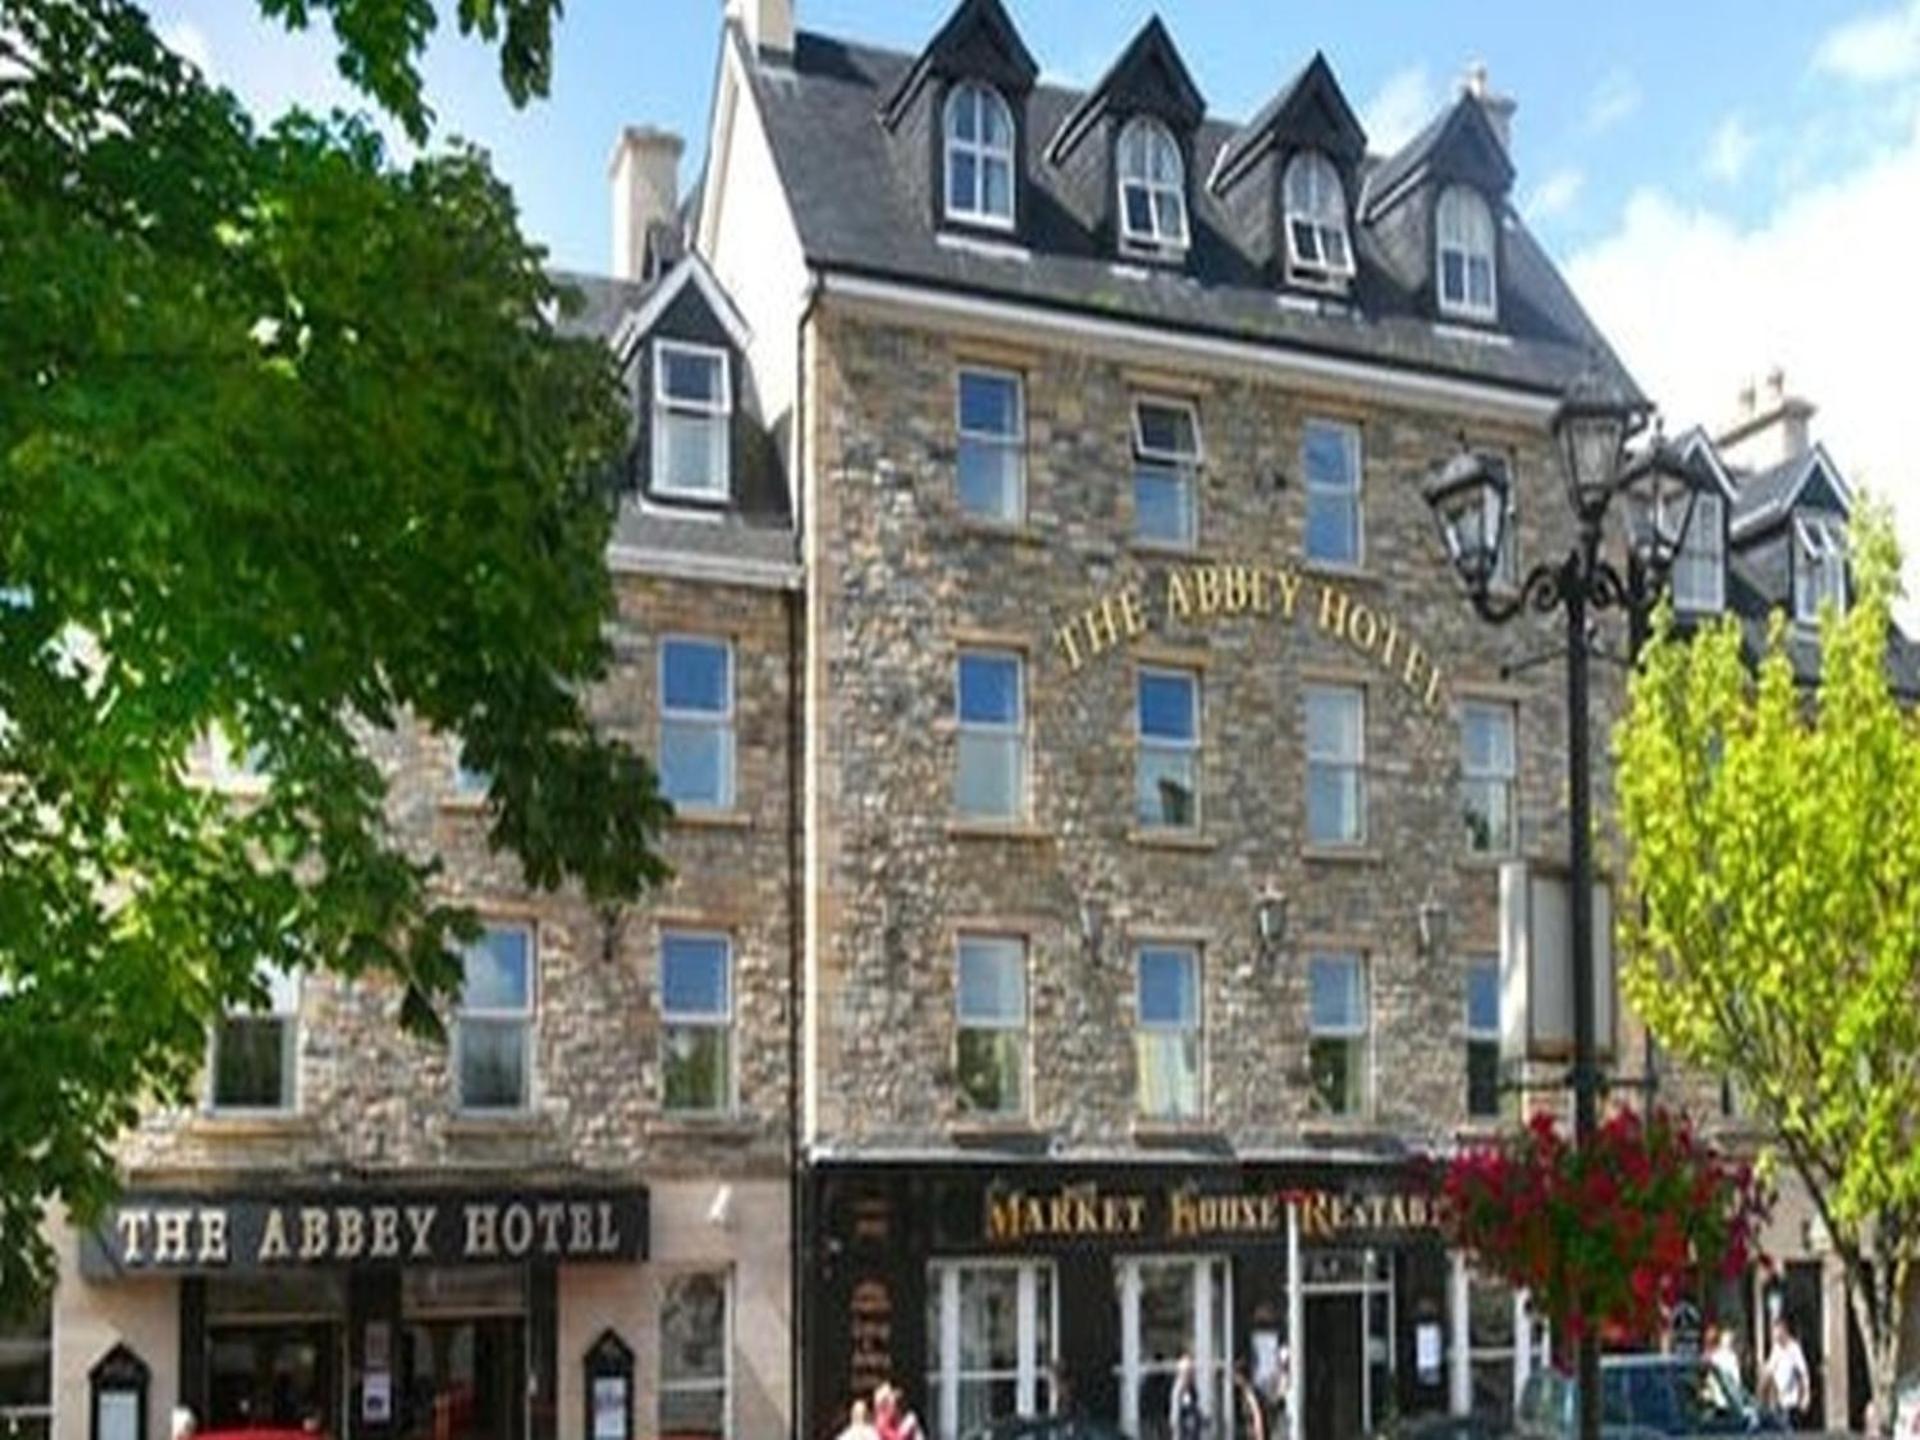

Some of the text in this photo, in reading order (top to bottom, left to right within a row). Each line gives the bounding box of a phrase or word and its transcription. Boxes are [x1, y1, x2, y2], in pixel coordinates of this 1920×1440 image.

[1054, 564, 1442, 706] THE ABBEY HOTEL
[118, 1202, 619, 1261] THE ABBEY HOTEL
